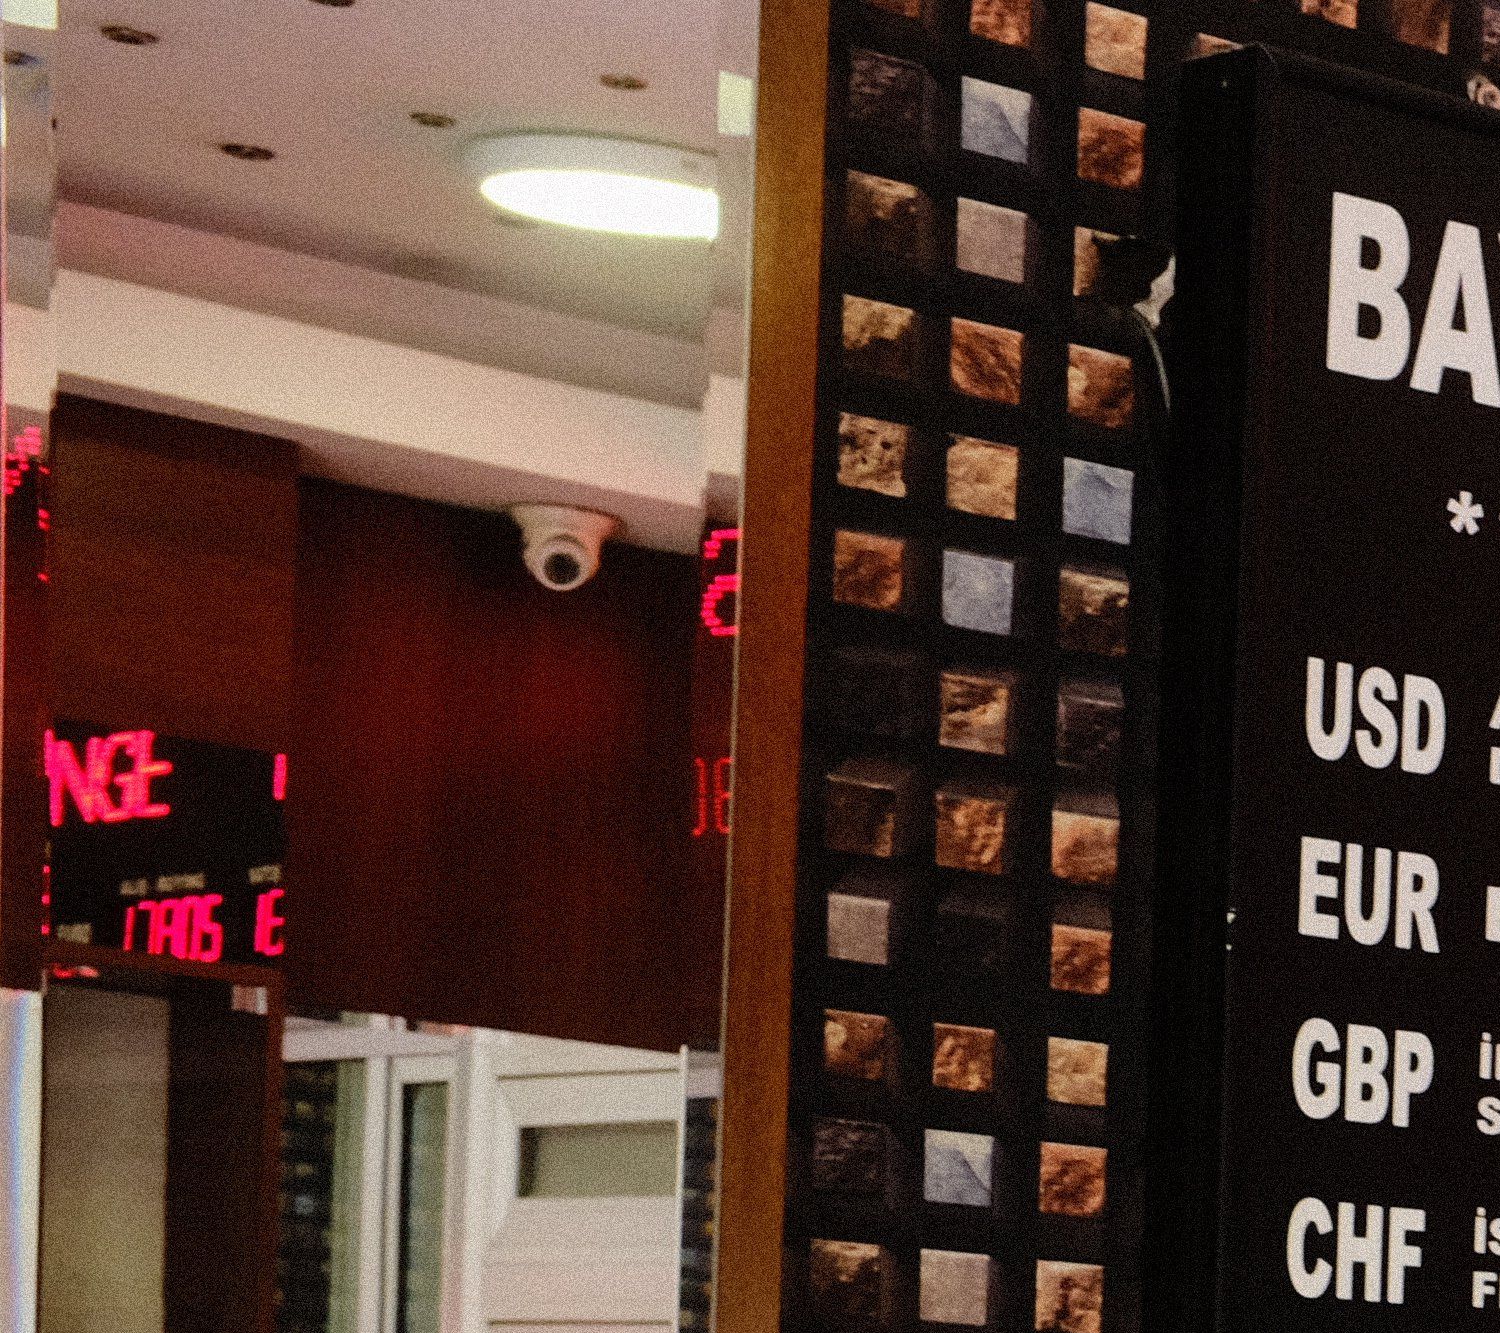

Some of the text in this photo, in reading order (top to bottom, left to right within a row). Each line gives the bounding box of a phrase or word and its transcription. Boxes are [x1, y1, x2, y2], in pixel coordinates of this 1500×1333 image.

[1306, 657, 1446, 775] USD
[1298, 836, 1439, 953] EUR
[1292, 1018, 1434, 1127] GBP
[1286, 1197, 1425, 1304] CHF
